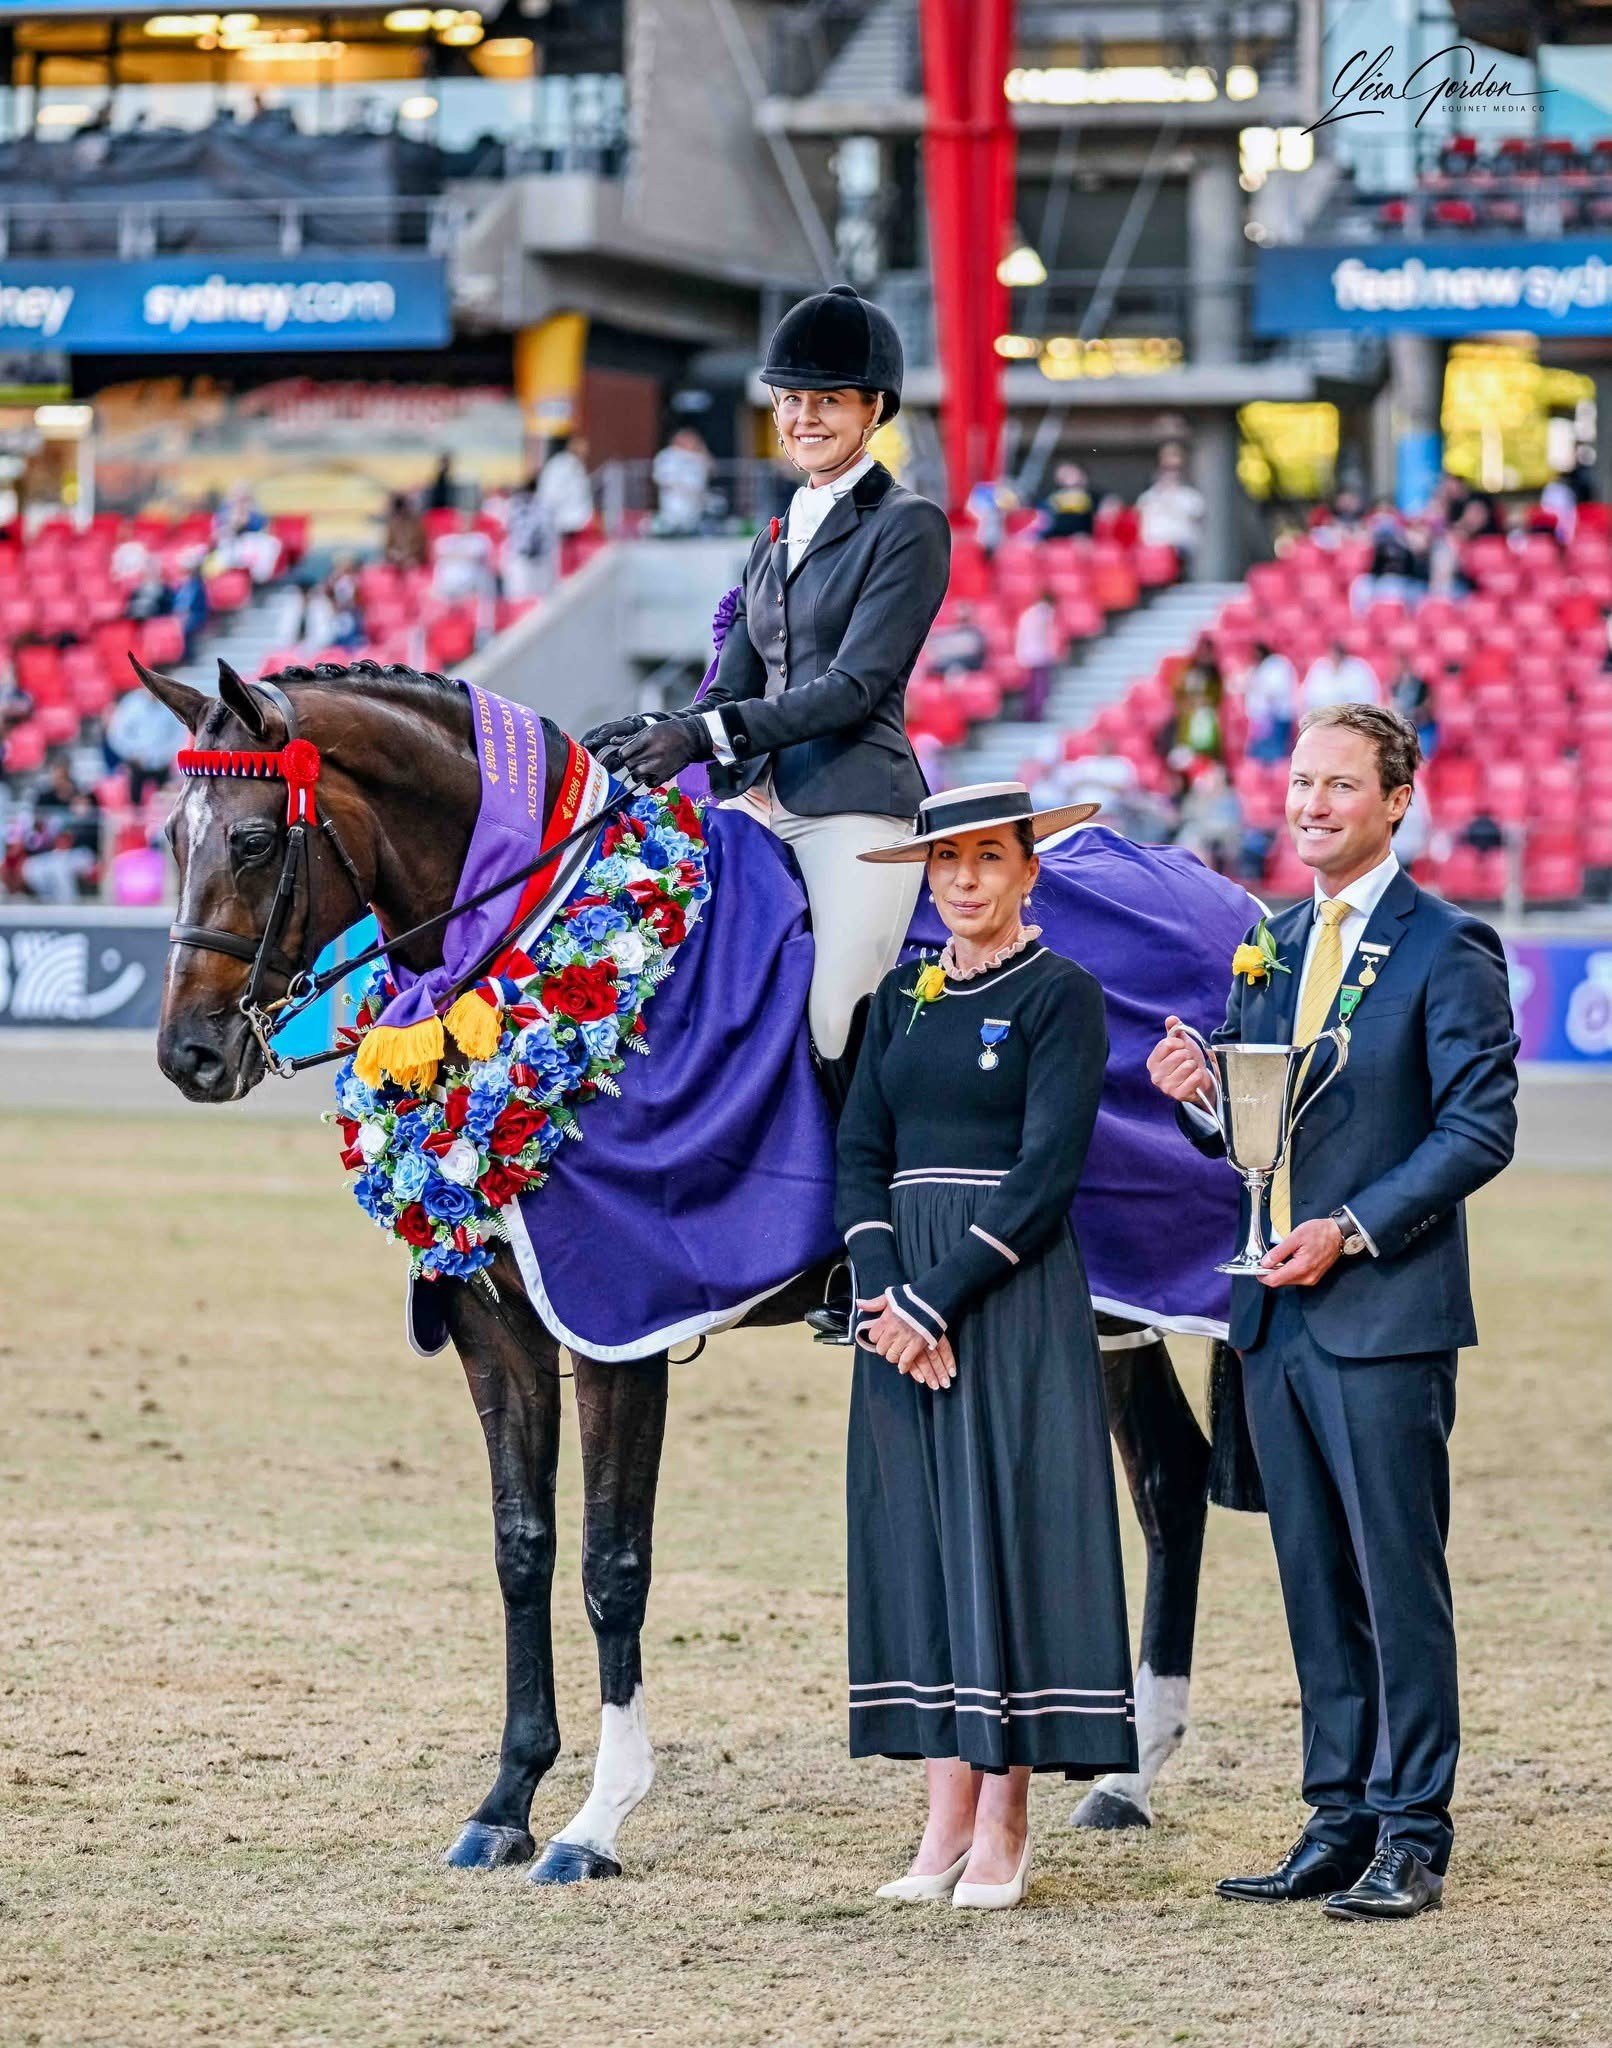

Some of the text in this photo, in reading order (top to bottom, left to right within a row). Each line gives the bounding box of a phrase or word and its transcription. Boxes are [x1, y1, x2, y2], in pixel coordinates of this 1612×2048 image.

[143, 274, 396, 333] sydney.com
[484, 739, 497, 770] 2026
[499, 702, 518, 784] THE MACKAY
[524, 718, 537, 820] AUSTRALIAN
[566, 776, 581, 809] 2026
